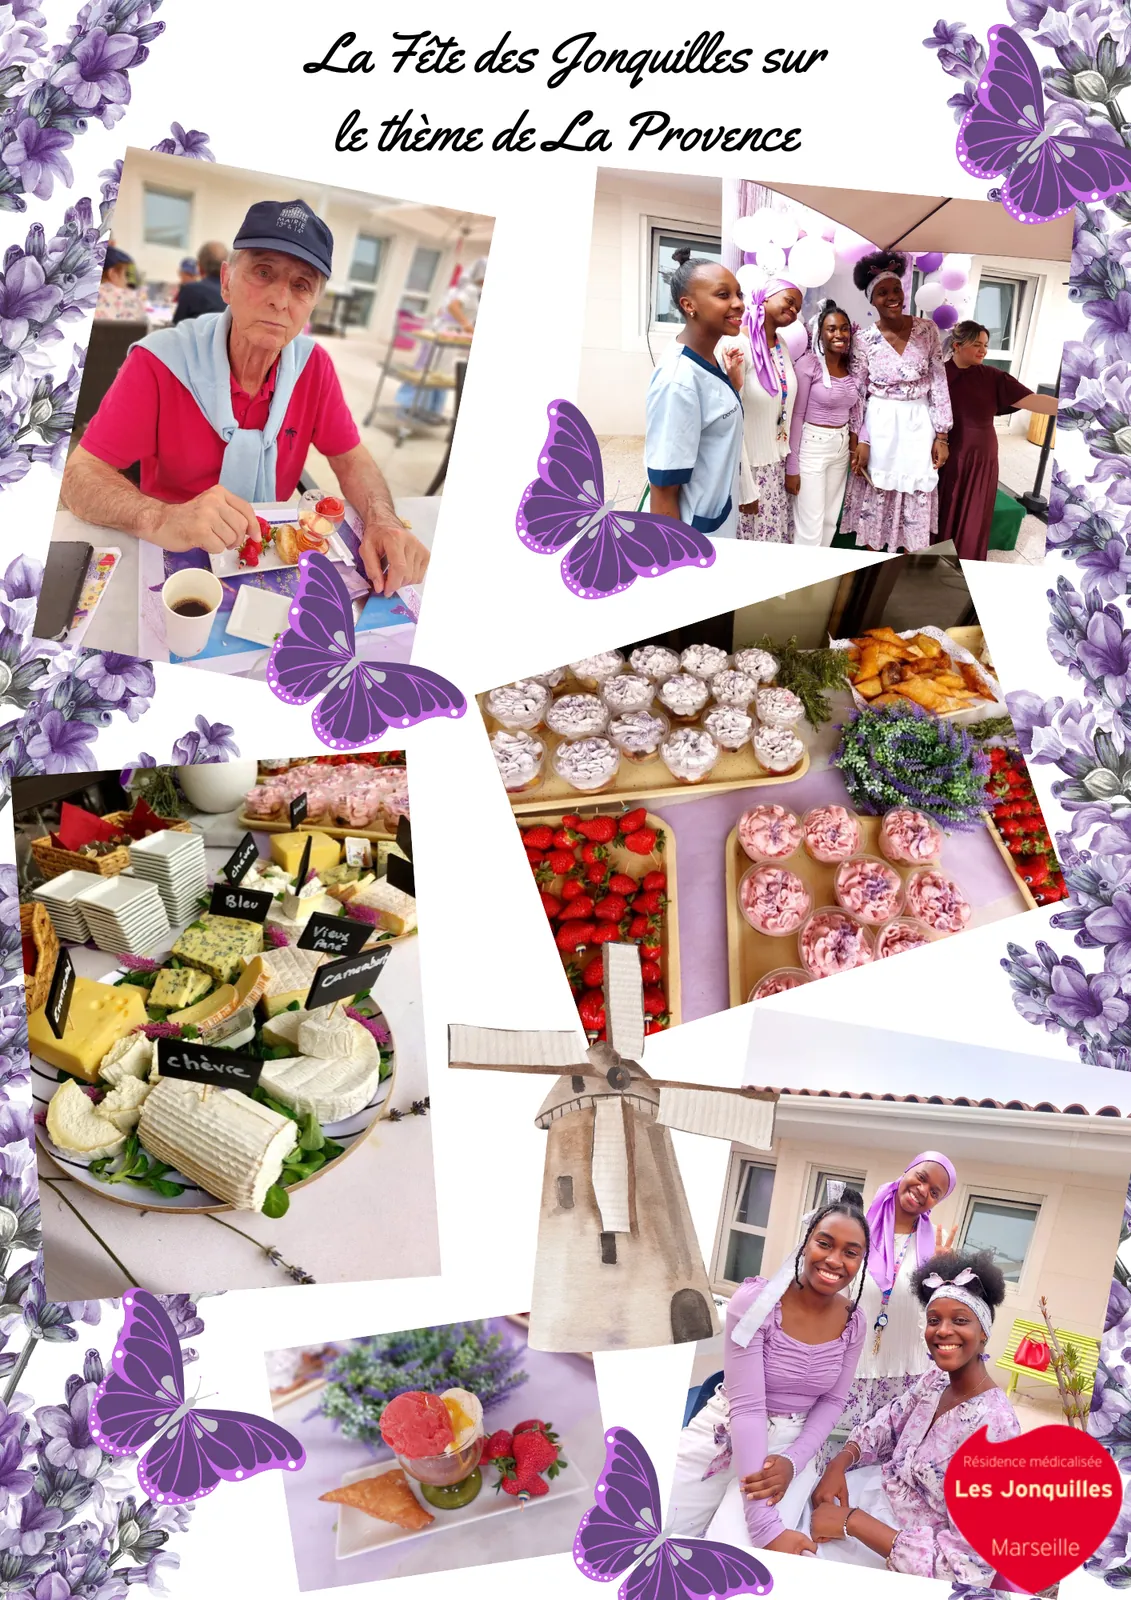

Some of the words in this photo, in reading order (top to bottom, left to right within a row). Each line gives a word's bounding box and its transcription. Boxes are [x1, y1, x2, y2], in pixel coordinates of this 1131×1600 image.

[276, 217, 306, 230] MAIRIE
[225, 894, 259, 909] Bleu
[313, 926, 350, 943] Vieux
[166, 1053, 251, 1078] chèvre
